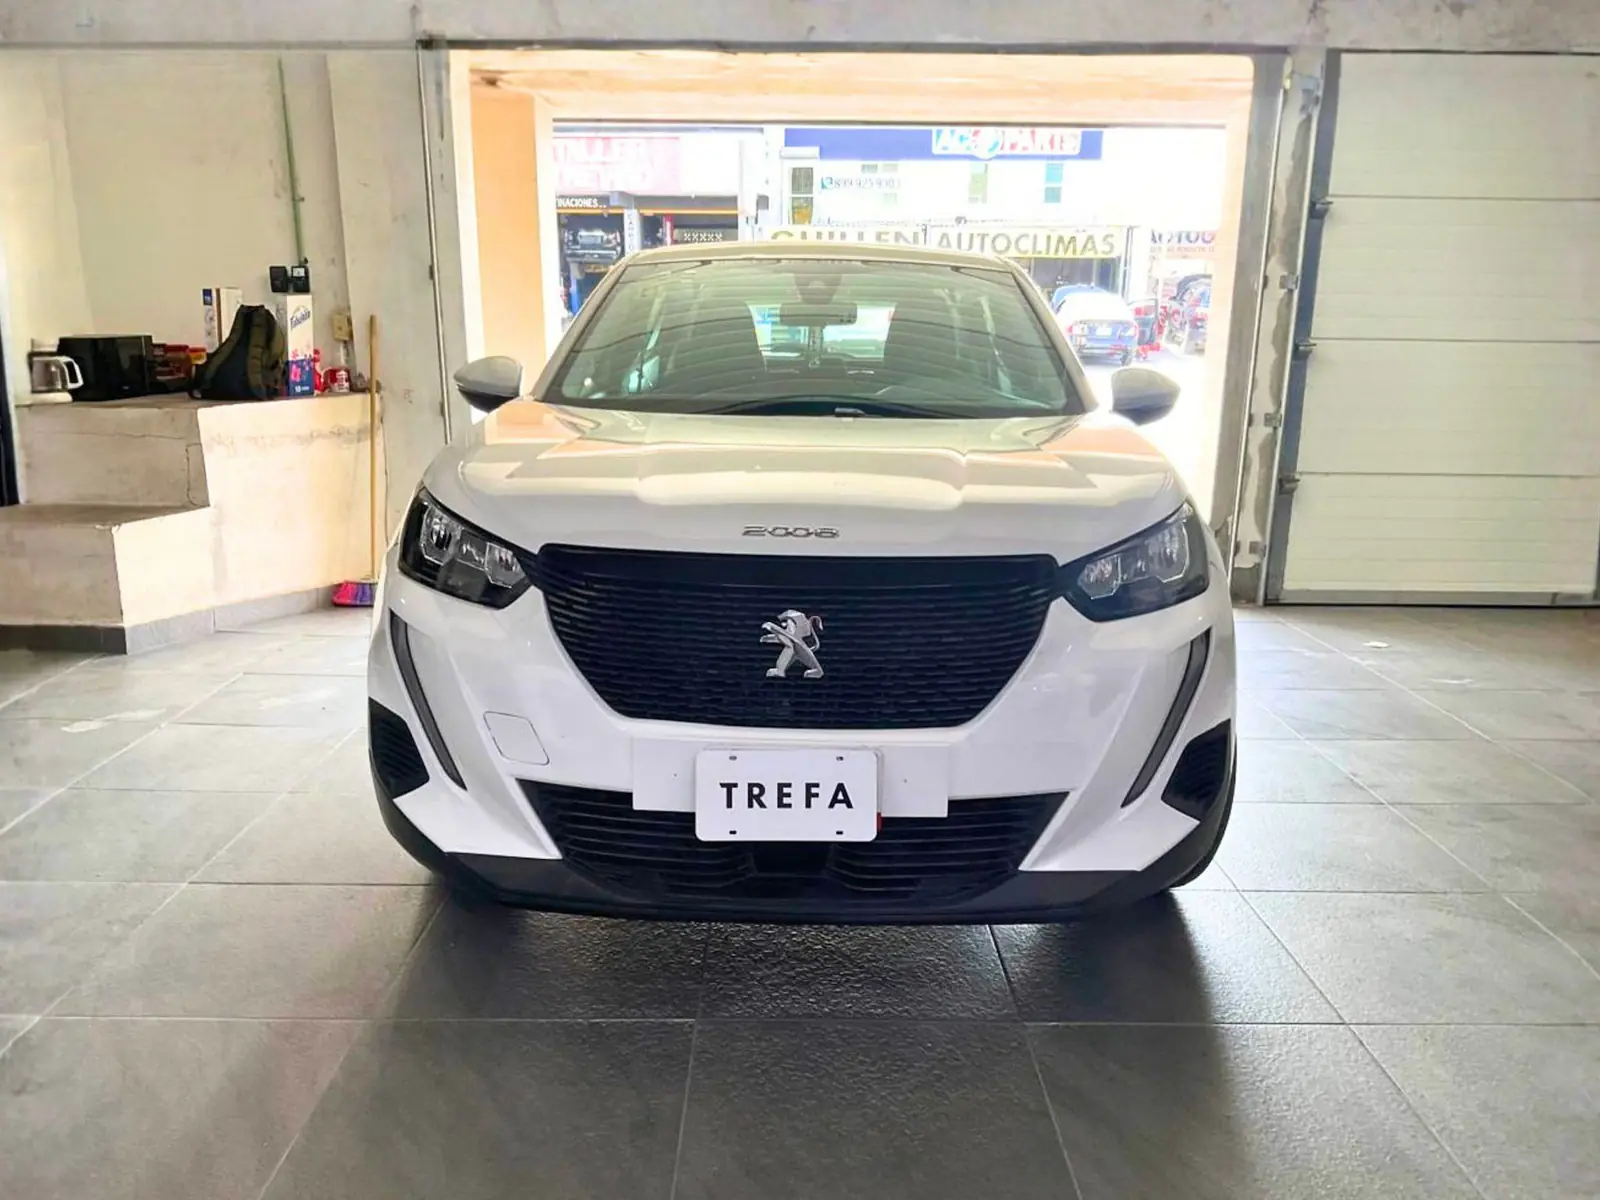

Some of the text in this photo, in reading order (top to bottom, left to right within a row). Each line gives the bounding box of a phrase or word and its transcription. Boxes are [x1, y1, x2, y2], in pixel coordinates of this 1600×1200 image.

[937, 232, 1115, 256] AUTOCLIMAS
[742, 526, 840, 538] 2008
[719, 782, 854, 809] TREFA
